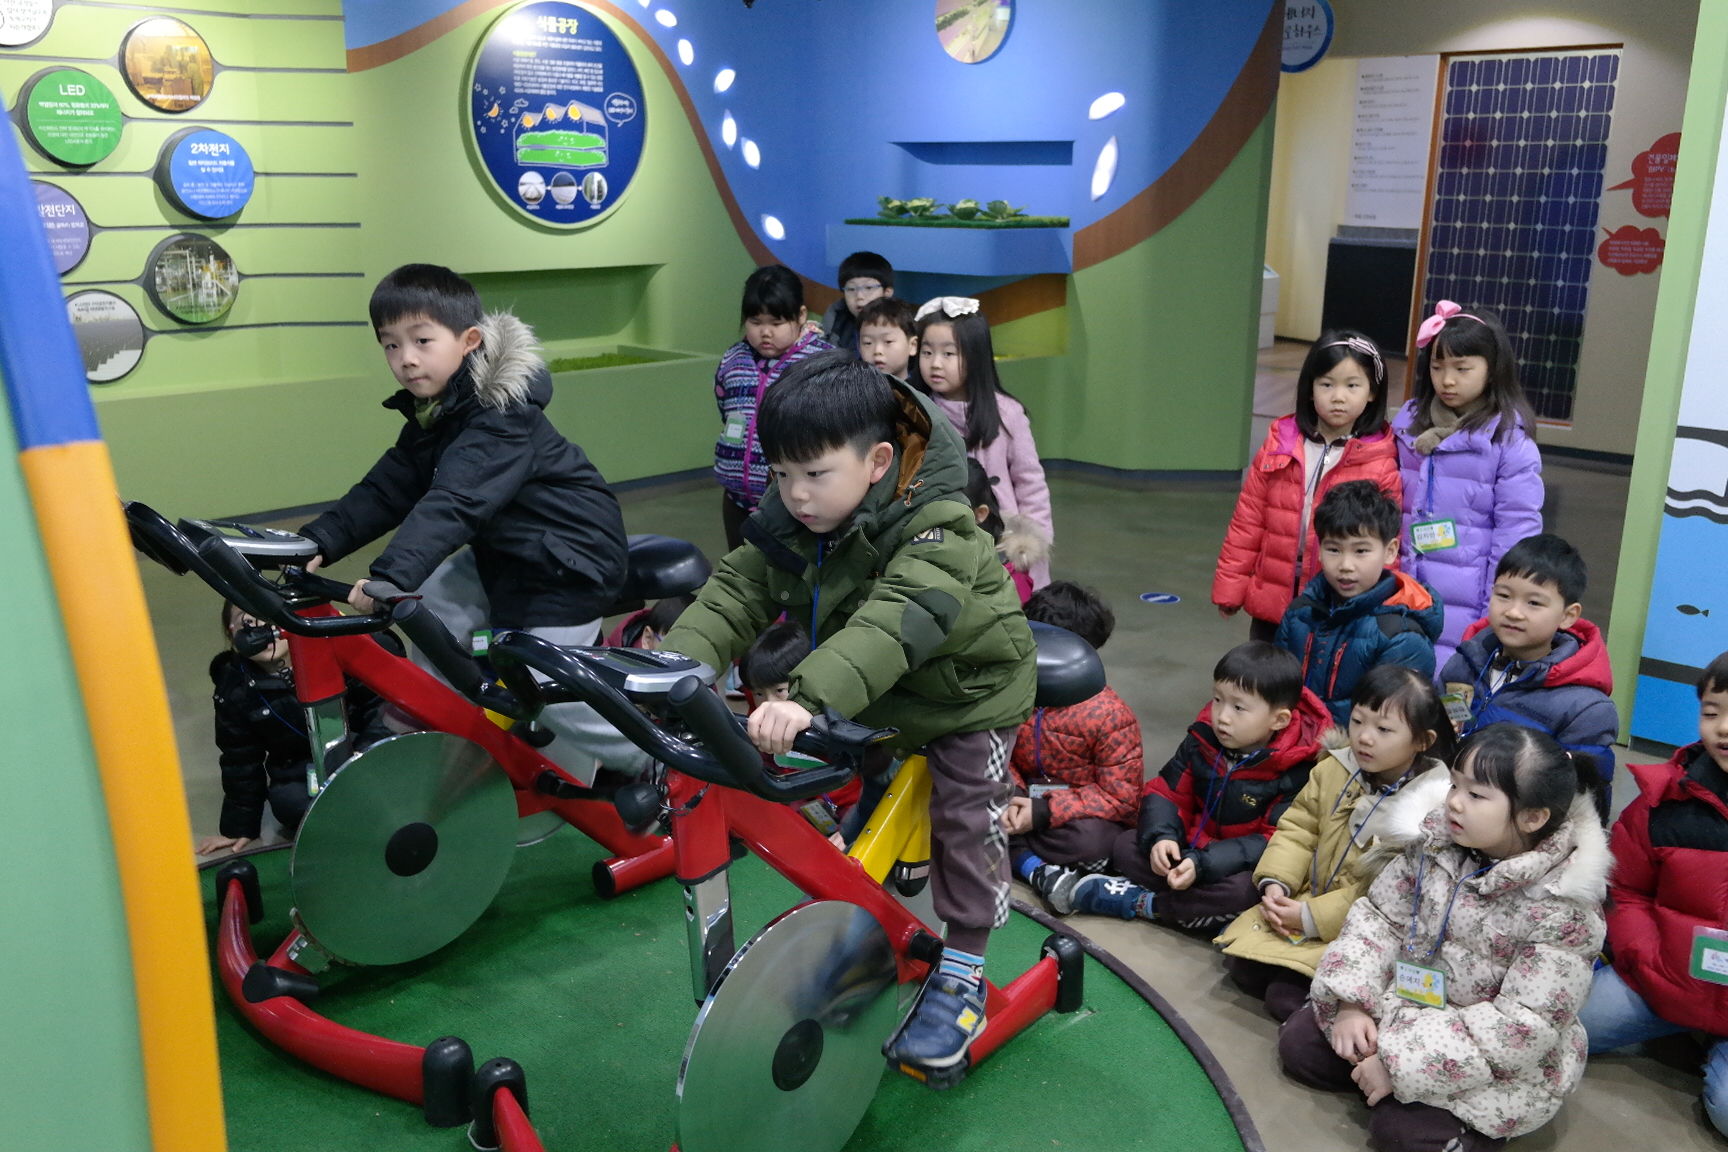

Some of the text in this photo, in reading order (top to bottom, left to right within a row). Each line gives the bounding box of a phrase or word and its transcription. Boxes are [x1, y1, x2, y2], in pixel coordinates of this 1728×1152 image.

[537, 16, 579, 35] 식물공장
[59, 84, 86, 96] LED
[190, 142, 230, 157] 2차전지
[956, 1006, 979, 1033] N
